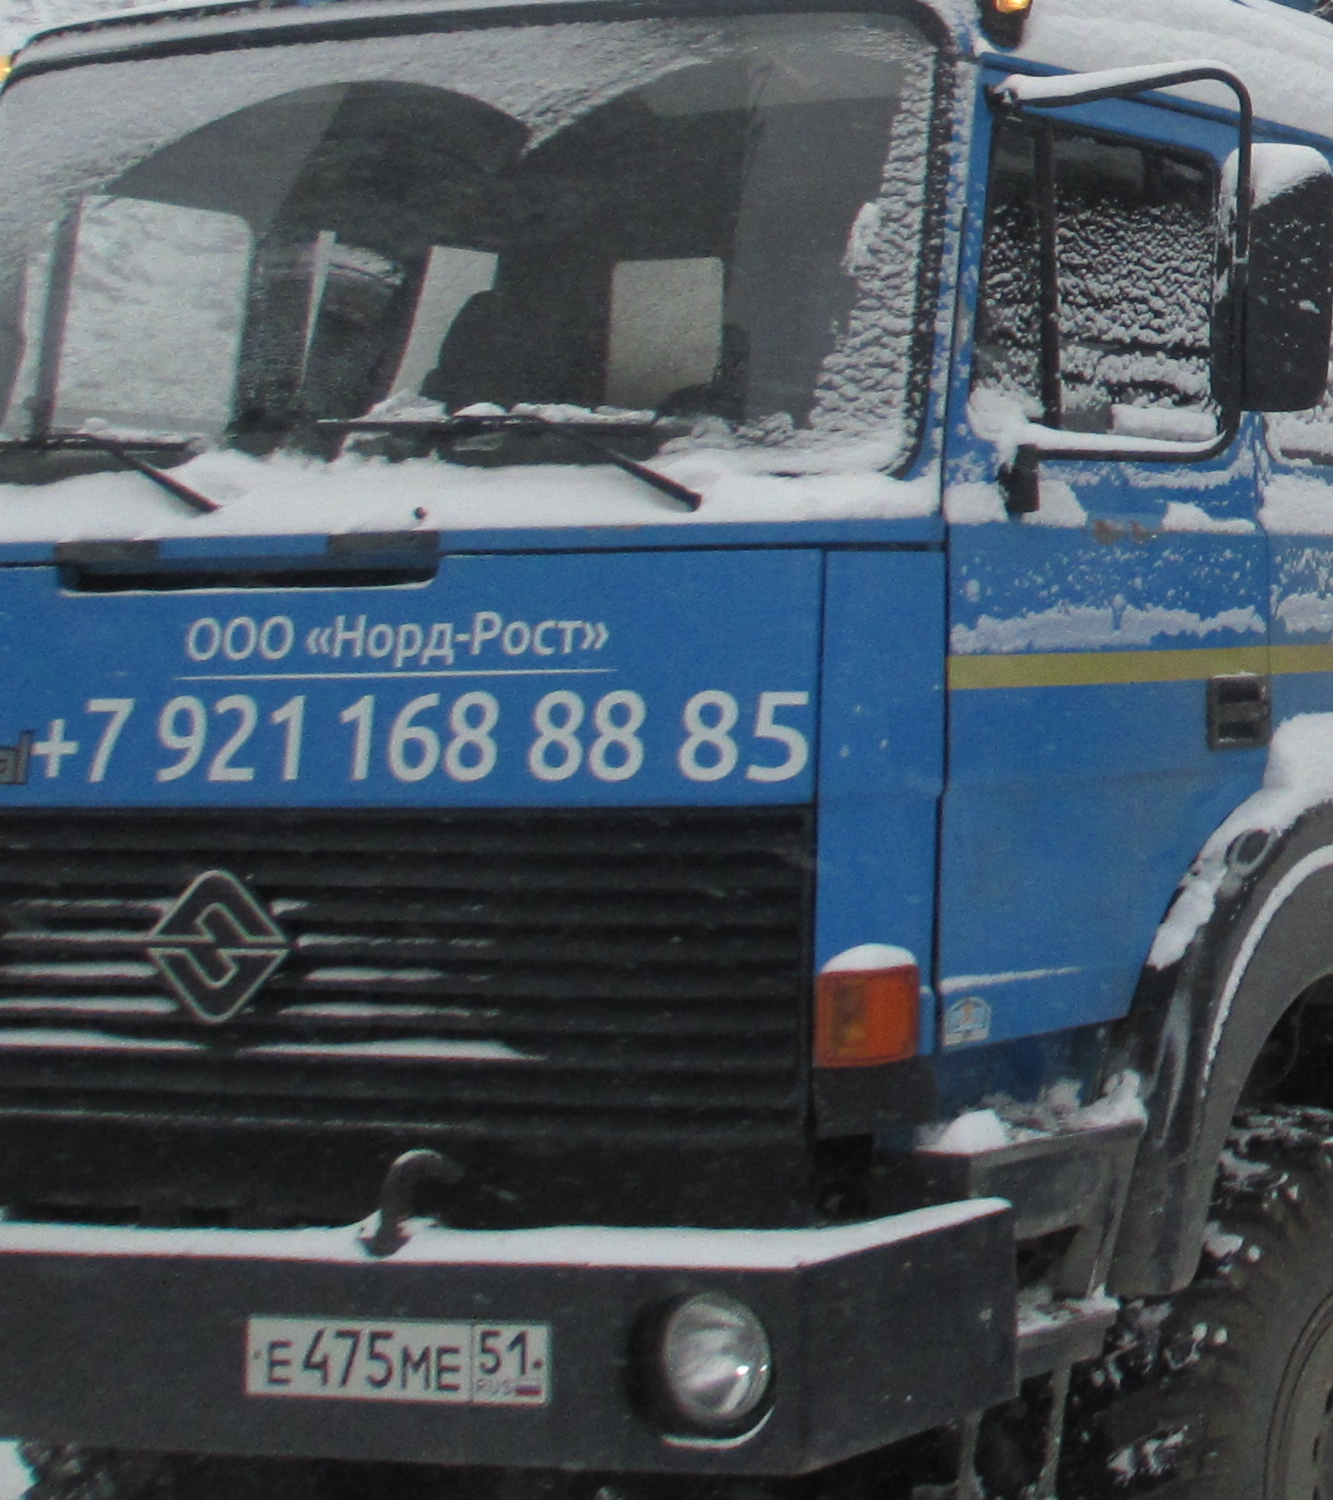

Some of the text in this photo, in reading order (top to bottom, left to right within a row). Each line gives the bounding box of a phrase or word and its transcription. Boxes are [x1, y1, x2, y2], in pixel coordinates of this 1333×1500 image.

[186, 611, 609, 668] ООО «Норд-Рост»
[31, 697, 134, 784] +7
[156, 693, 305, 784] 921
[340, 691, 499, 783] 168
[527, 689, 646, 783] 88
[677, 688, 810, 784] 85
[479, 1329, 530, 1377] 51
